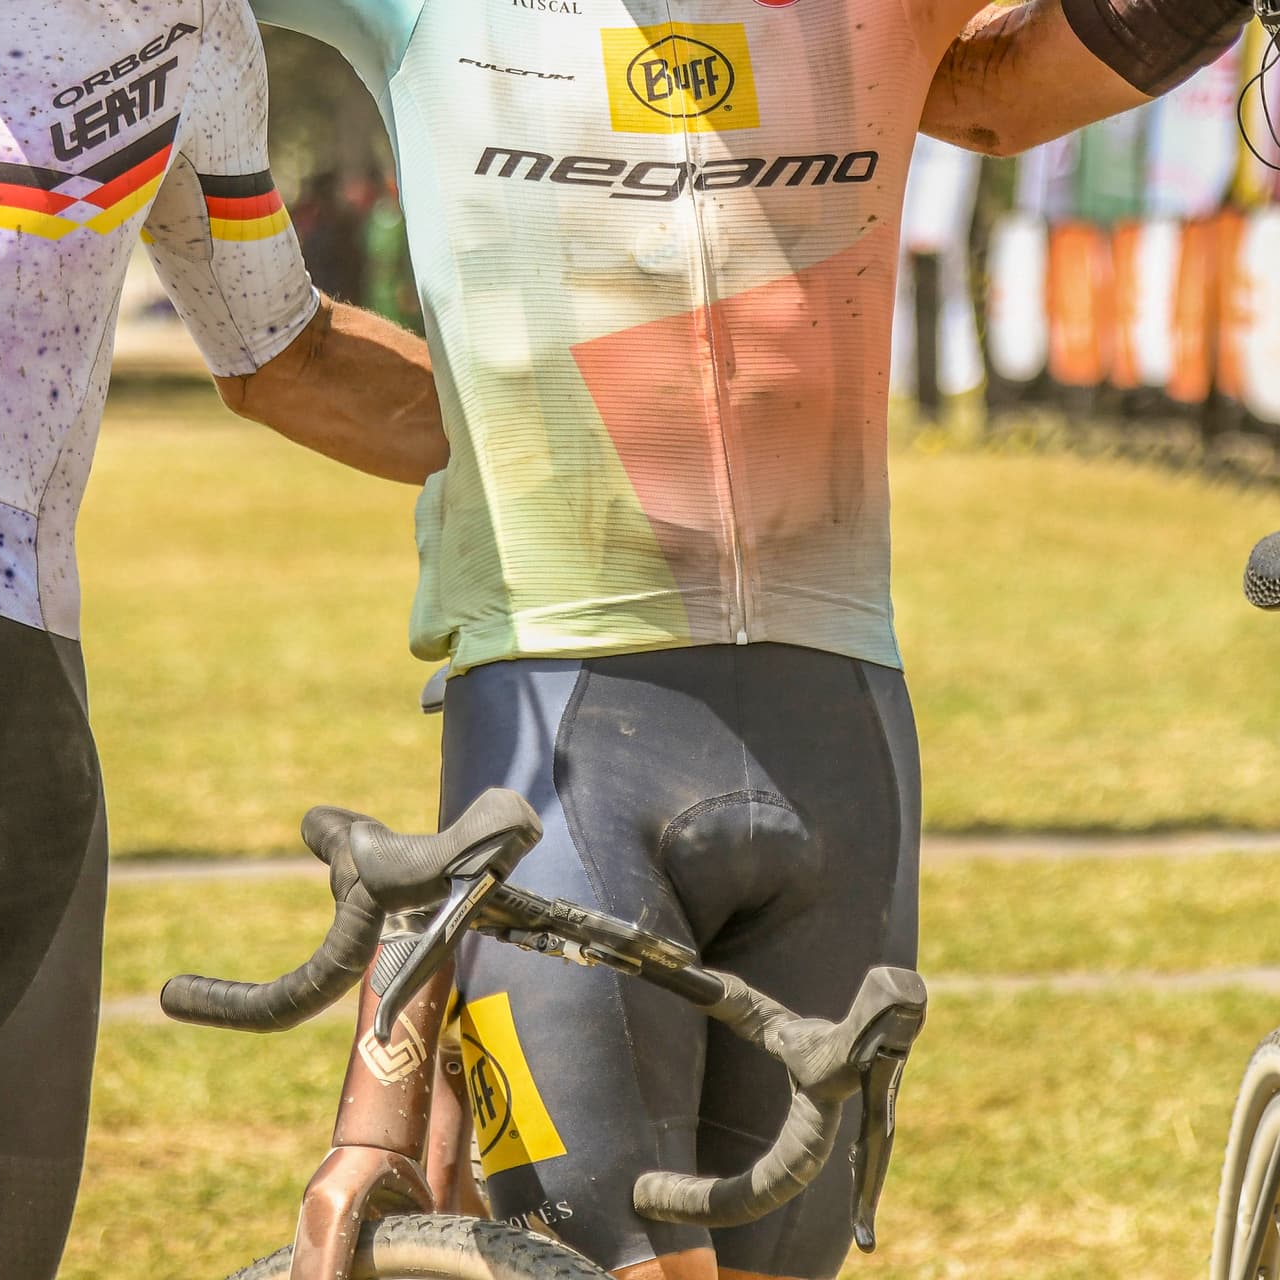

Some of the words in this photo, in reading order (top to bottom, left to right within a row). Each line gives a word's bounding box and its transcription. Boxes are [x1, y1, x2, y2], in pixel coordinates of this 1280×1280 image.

[52, 22, 199, 110] ORBEA
[458, 57, 576, 81] FULCRUM
[50, 55, 179, 162] LEATT
[474, 146, 879, 201] megamo
